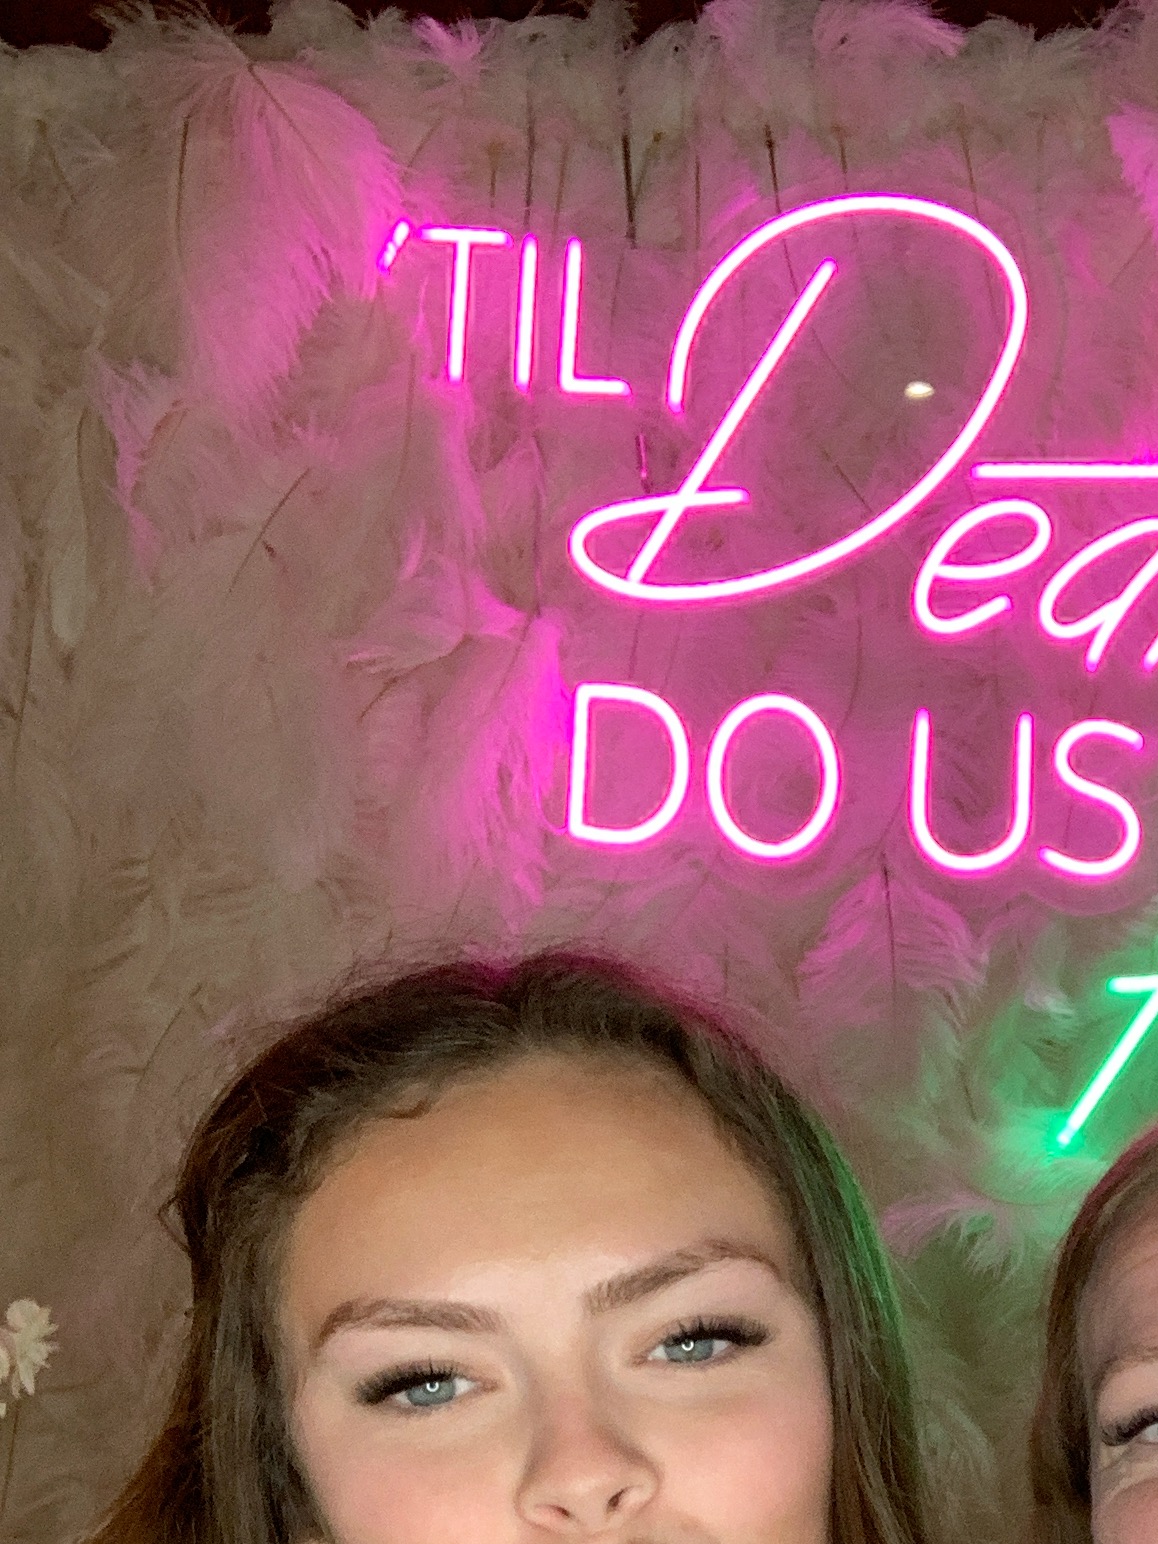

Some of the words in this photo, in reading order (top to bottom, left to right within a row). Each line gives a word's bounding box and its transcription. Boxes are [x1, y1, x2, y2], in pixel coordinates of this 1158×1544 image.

[380, 222, 632, 397] 'TIL
[566, 682, 840, 860] DO
[909, 708, 1145, 877] US
